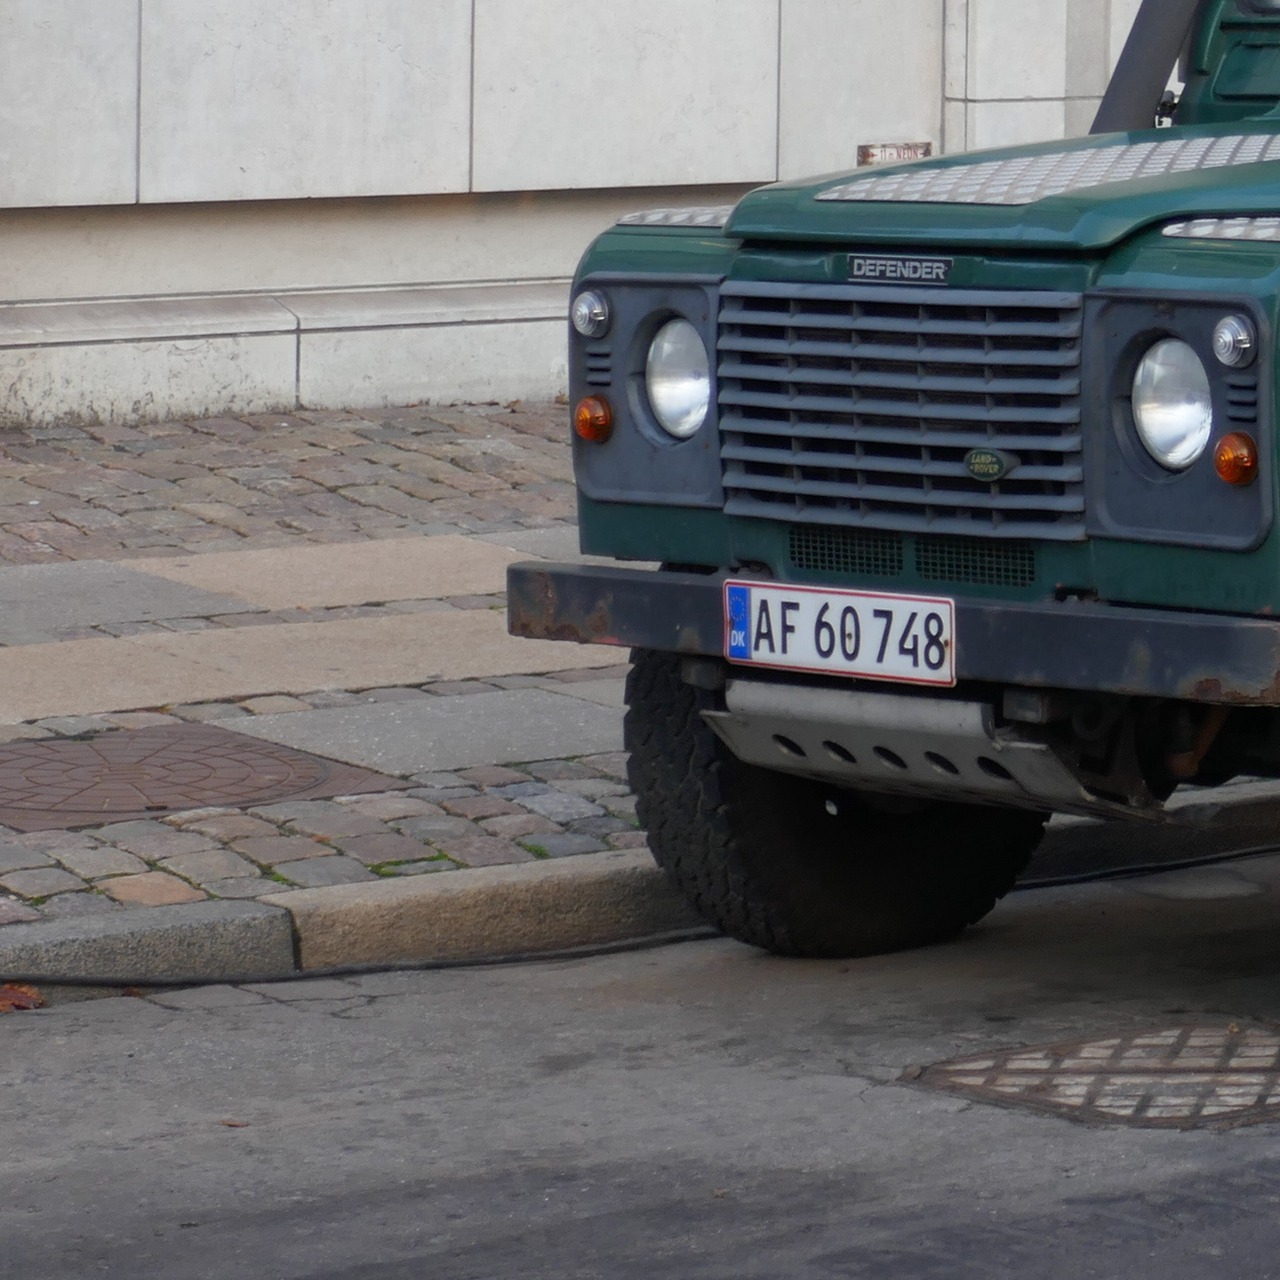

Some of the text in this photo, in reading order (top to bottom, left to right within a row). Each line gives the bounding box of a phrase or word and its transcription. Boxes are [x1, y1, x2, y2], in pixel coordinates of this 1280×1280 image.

[853, 258, 945, 280] DEFENDER
[971, 454, 992, 464] LAND
[974, 463, 999, 474] ROVER
[731, 630, 745, 648] DK
[753, 599, 945, 671] AF 60 748
